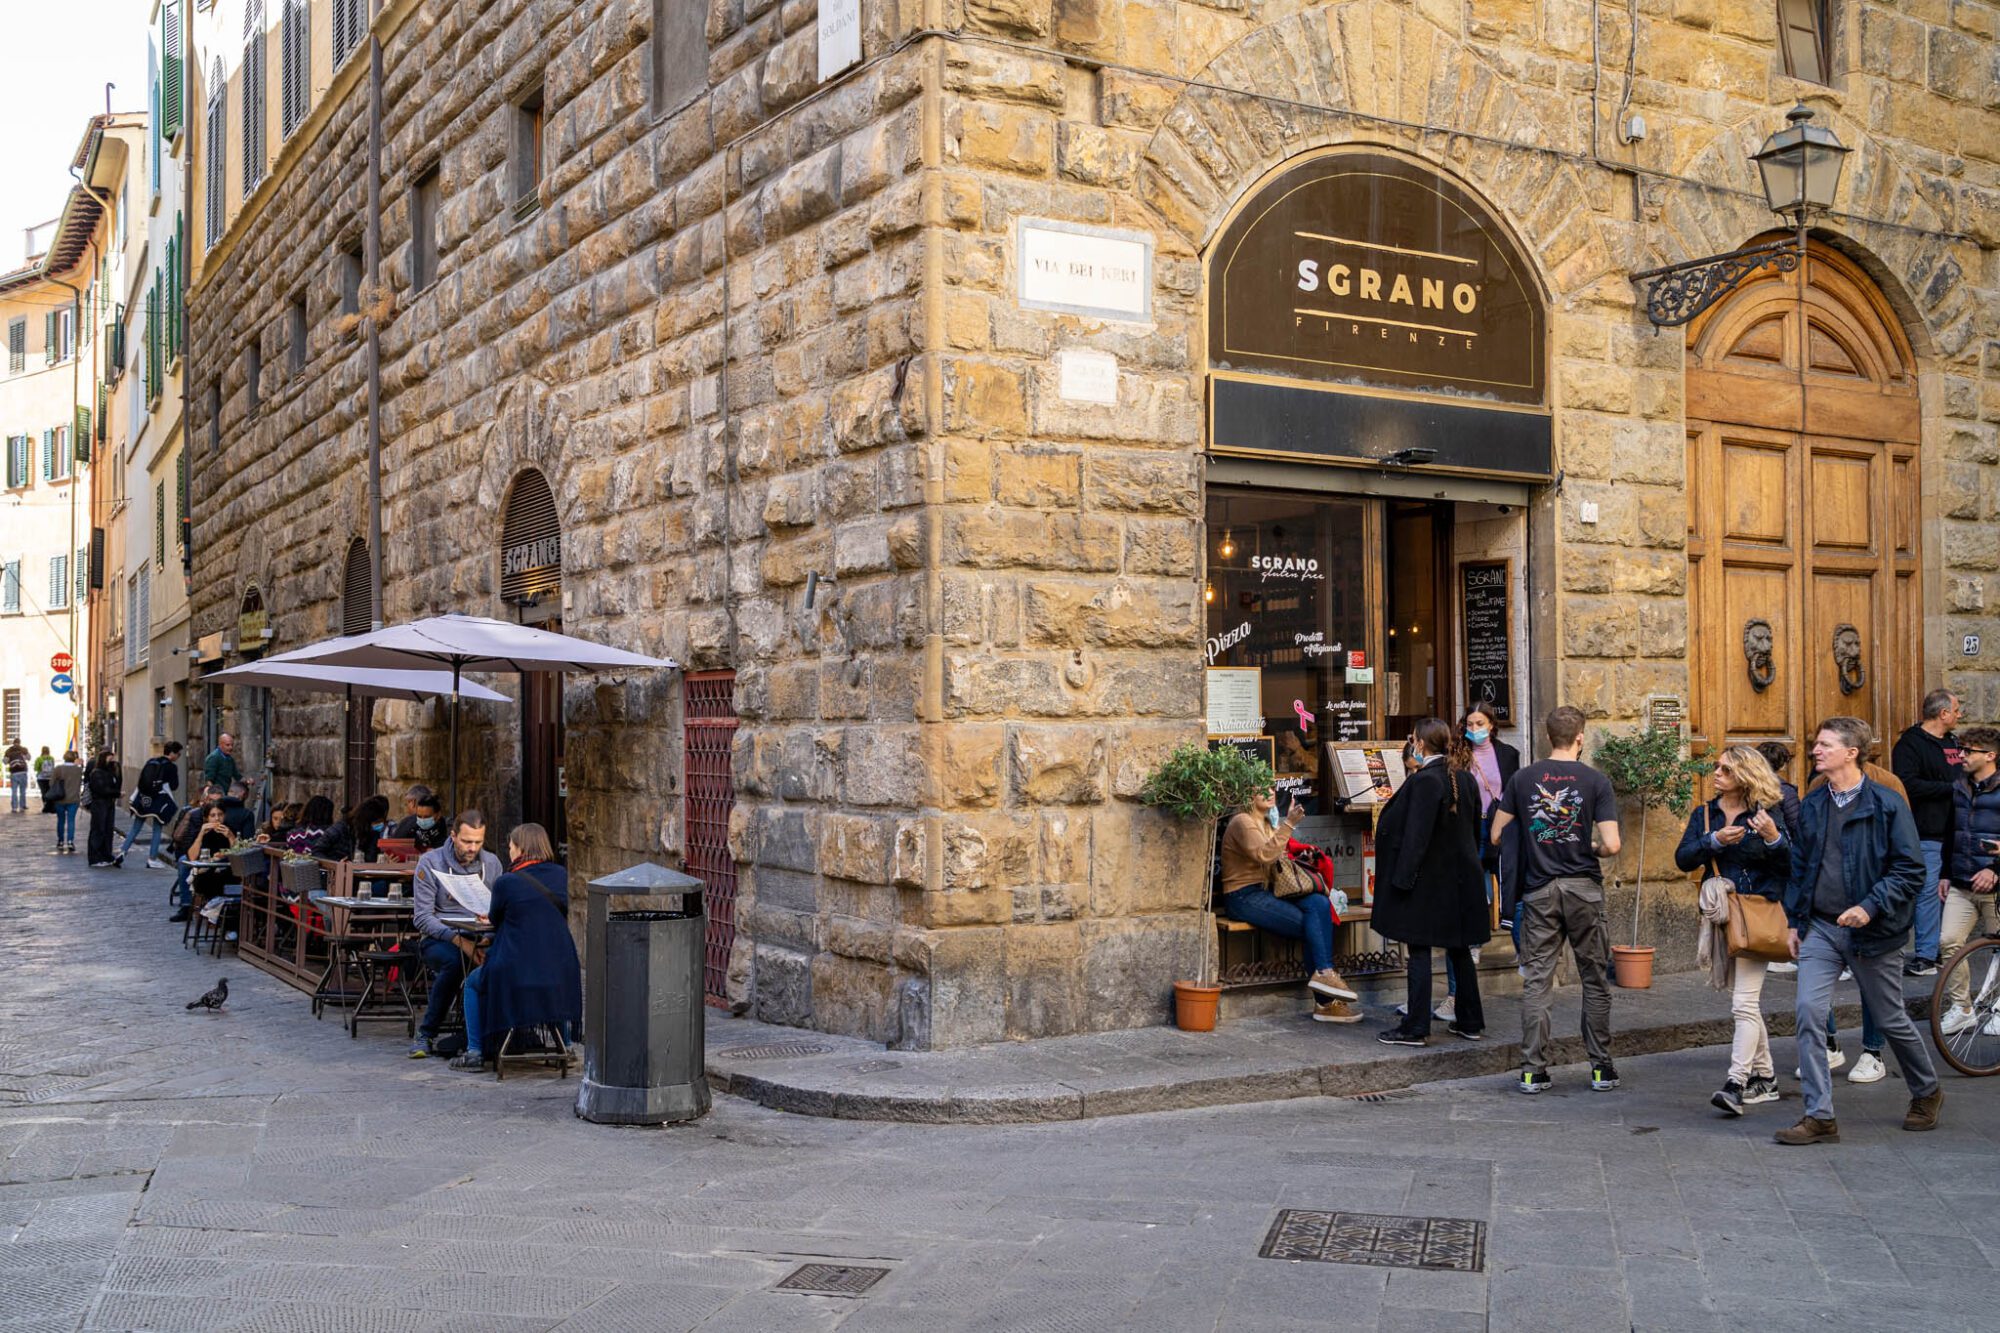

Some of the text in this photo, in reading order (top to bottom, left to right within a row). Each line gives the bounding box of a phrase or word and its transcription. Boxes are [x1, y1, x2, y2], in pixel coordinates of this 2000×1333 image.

[1034, 257, 1059, 273] VIA
[1069, 262, 1093, 277] DEI
[1297, 259, 1477, 314] SGRANO
[1296, 316, 1473, 350] FIRENZE
[505, 536, 558, 576] SGRANO
[1252, 555, 1318, 572] SGRANO
[1261, 566, 1325, 583] gluten free
[1204, 621, 1251, 666] Pizza
[1294, 631, 1324, 646] Prodotti
[1965, 637, 1978, 653] 25
[1303, 642, 1342, 658] Artigianali
[52, 658, 73, 667] STOP
[1275, 776, 1304, 792] Taglieri
